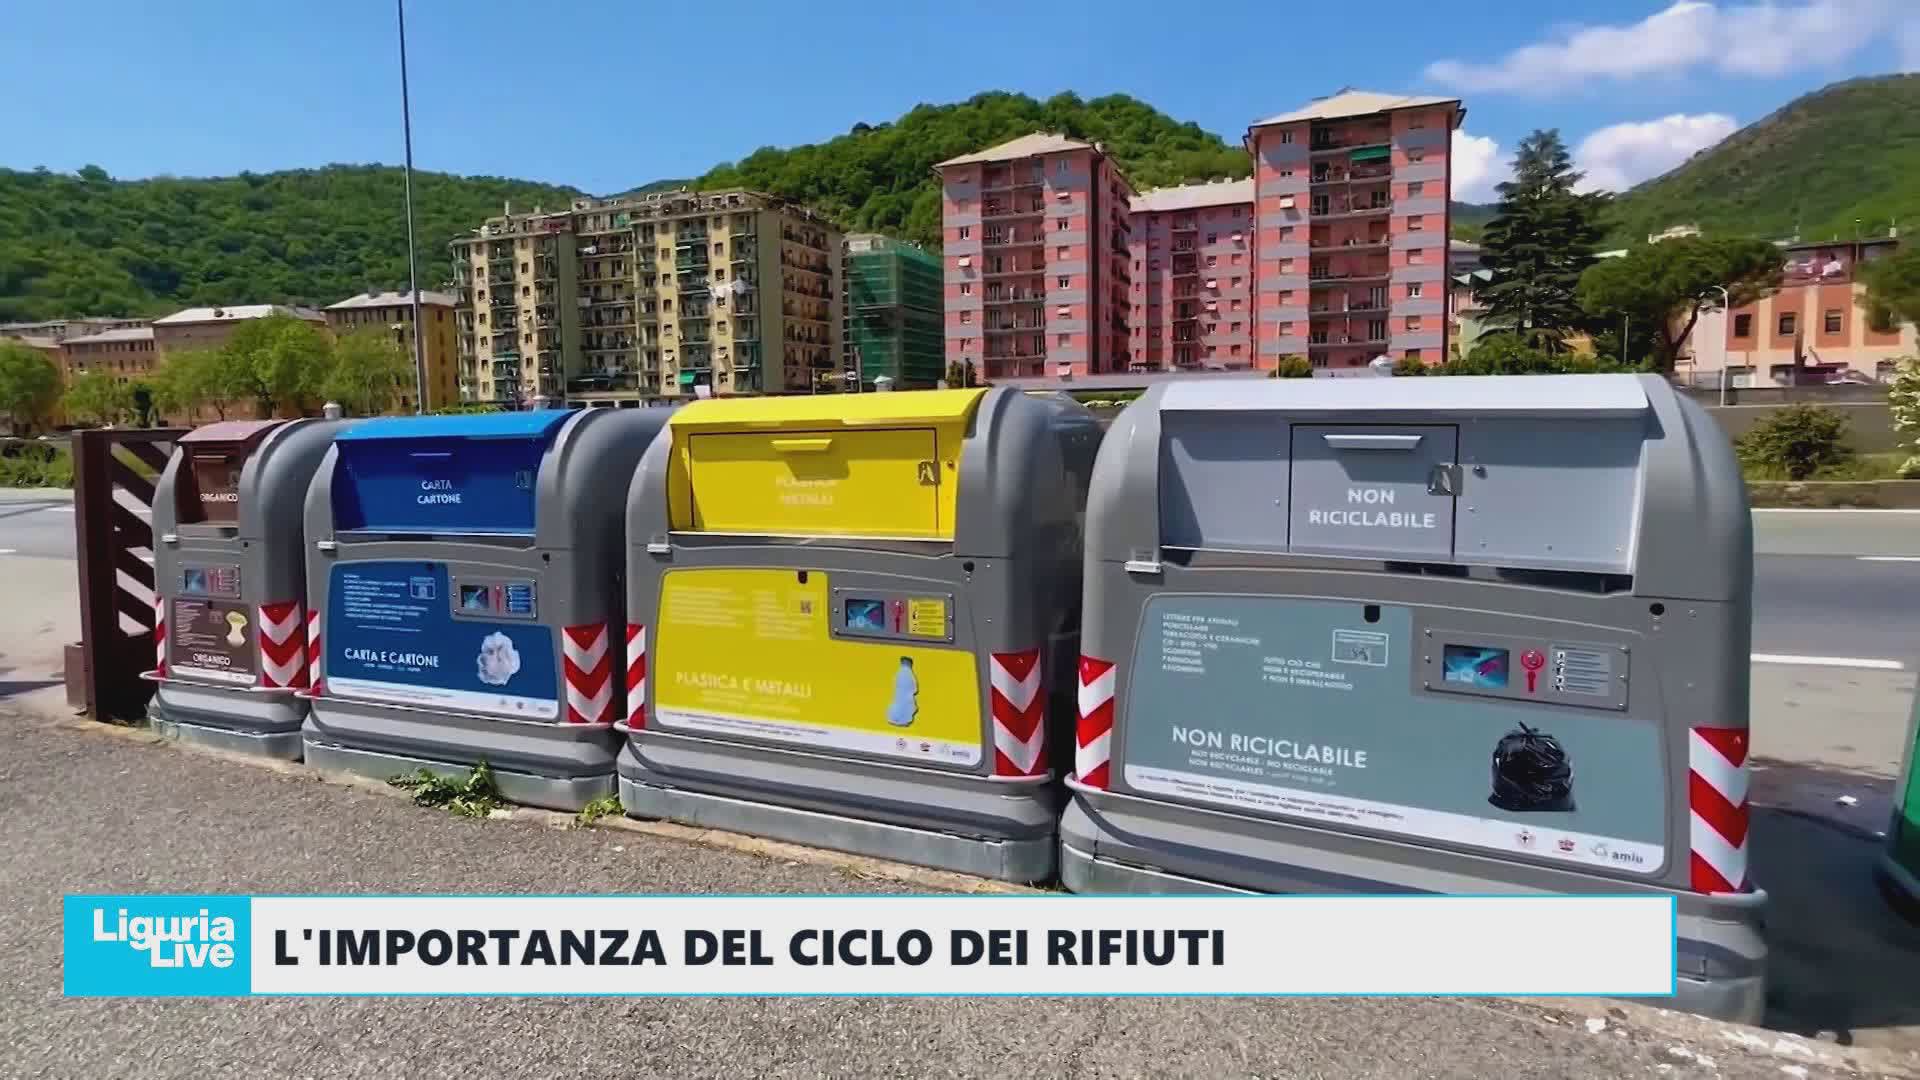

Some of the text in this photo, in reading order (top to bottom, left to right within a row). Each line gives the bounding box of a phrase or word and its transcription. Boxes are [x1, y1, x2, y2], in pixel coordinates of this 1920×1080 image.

[421, 479, 452, 491] CARTA
[200, 492, 239, 502] ORGANICO
[417, 493, 462, 504] CARTONE
[1347, 487, 1395, 504] NON
[1308, 510, 1437, 529] RICICLABILE
[192, 653, 231, 666] ORGANICO
[344, 647, 378, 662] CARTA
[381, 651, 388, 662] E
[389, 652, 440, 668] CARTONE
[676, 671, 812, 697] PLASTICA E METALLI
[1172, 725, 1368, 769] NON RICICLABILE
[1611, 850, 1644, 864] amiu
